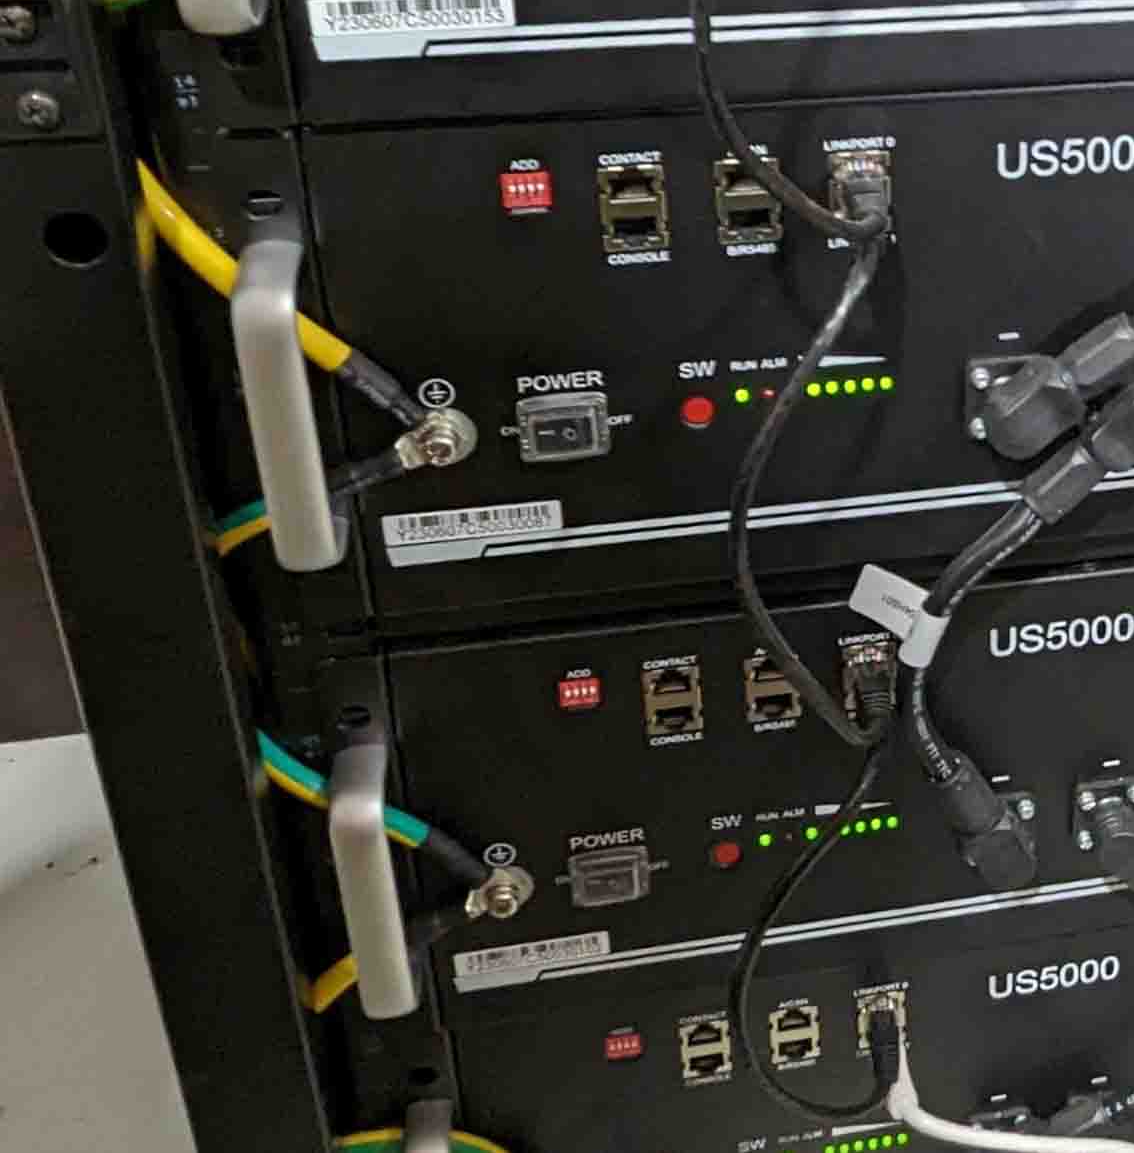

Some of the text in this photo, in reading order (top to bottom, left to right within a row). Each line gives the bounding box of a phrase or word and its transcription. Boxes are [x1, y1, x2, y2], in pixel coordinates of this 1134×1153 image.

[509, 158, 540, 172] ADD
[598, 151, 662, 166] CONTACT
[607, 250, 672, 266] CONSOLE
[678, 359, 717, 379] SW
[516, 369, 605, 394] POWER
[711, 814, 743, 831] SW
[568, 828, 645, 850] POWER
[988, 956, 1121, 999] US5000
